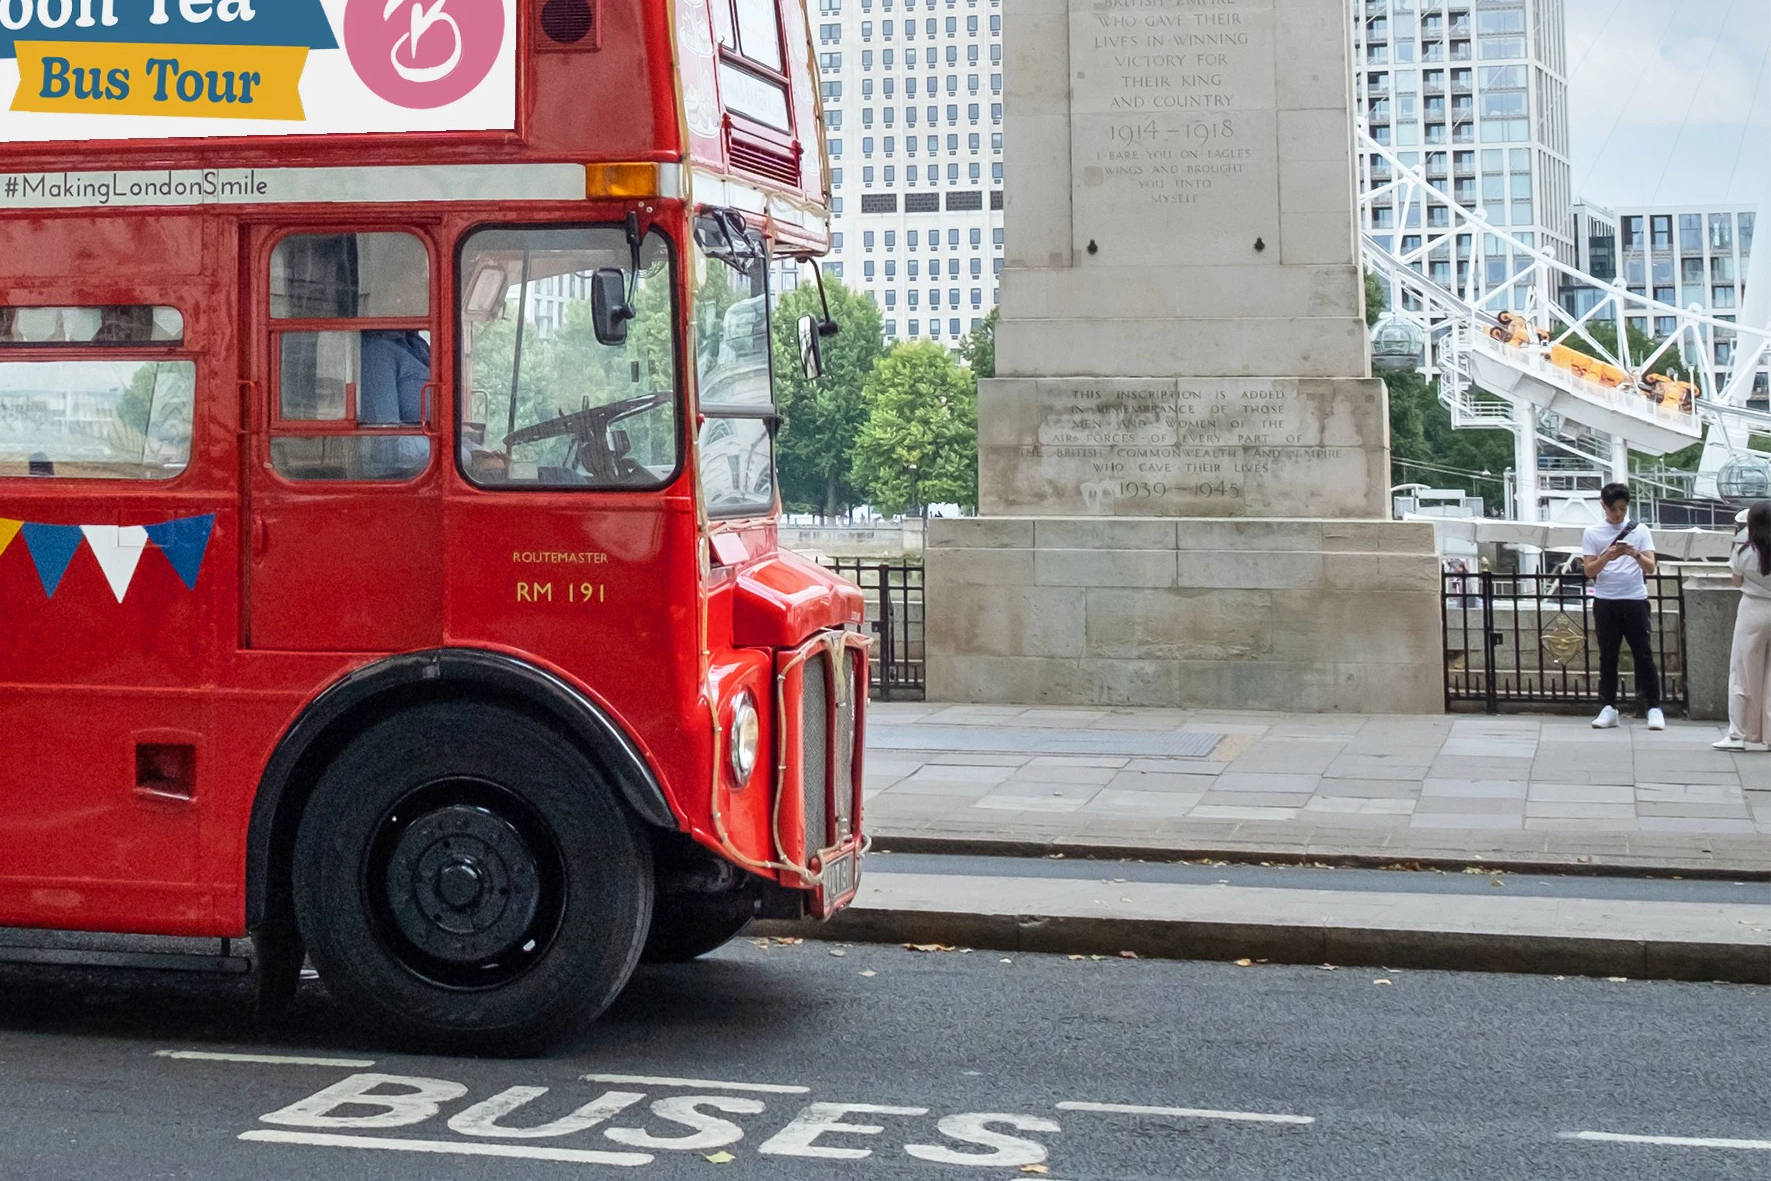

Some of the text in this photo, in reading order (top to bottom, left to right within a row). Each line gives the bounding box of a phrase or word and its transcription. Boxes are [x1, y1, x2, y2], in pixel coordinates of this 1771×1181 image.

[1099, 13, 1241, 27] WHO GAVE THEIR
[1095, 33, 1248, 48] LIVES IN WINNING
[1115, 54, 1228, 67] VICTORY FOR
[40, 56, 261, 104] Bus Tour
[1121, 74, 1221, 88] THEIR KING
[1110, 94, 1233, 107] AND COUNTRY
[1111, 120, 1159, 149] 1914
[1186, 120, 1234, 147] 1918
[1109, 151, 1138, 160] BARE
[1146, 151, 1171, 159] YOU
[1180, 150, 1198, 158] ON
[1208, 149, 1251, 158] EAGLES
[1106, 164, 1244, 175] WINGS AND BROUGHT
[4, 169, 268, 204] #MakingLondonSmile
[1139, 179, 1211, 188] YOU UNTO
[1072, 391, 1284, 399] THIS INSCRIPTION IS ADDED
[1071, 405, 1284, 414] IN REMEMBRANCE OF THOSE
[1072, 419, 1284, 428] MEN AND WOMEN OF THE
[1052, 434, 1303, 443] AIR FORCES OF EVERY PART OF
[1020, 449, 1341, 458] THE BRITISH COMMONWEALTH AND EMPIRE
[1093, 463, 1124, 471] WHO
[1186, 463, 1220, 472] THEIR
[1235, 463, 1268, 472] LIVES
[1120, 482, 1166, 498] 1939
[1195, 481, 1239, 498] 1945
[513, 551, 608, 564] ROUTEMASTER
[517, 581, 605, 603] RM 191
[258, 1072, 1062, 1167] BUSES
